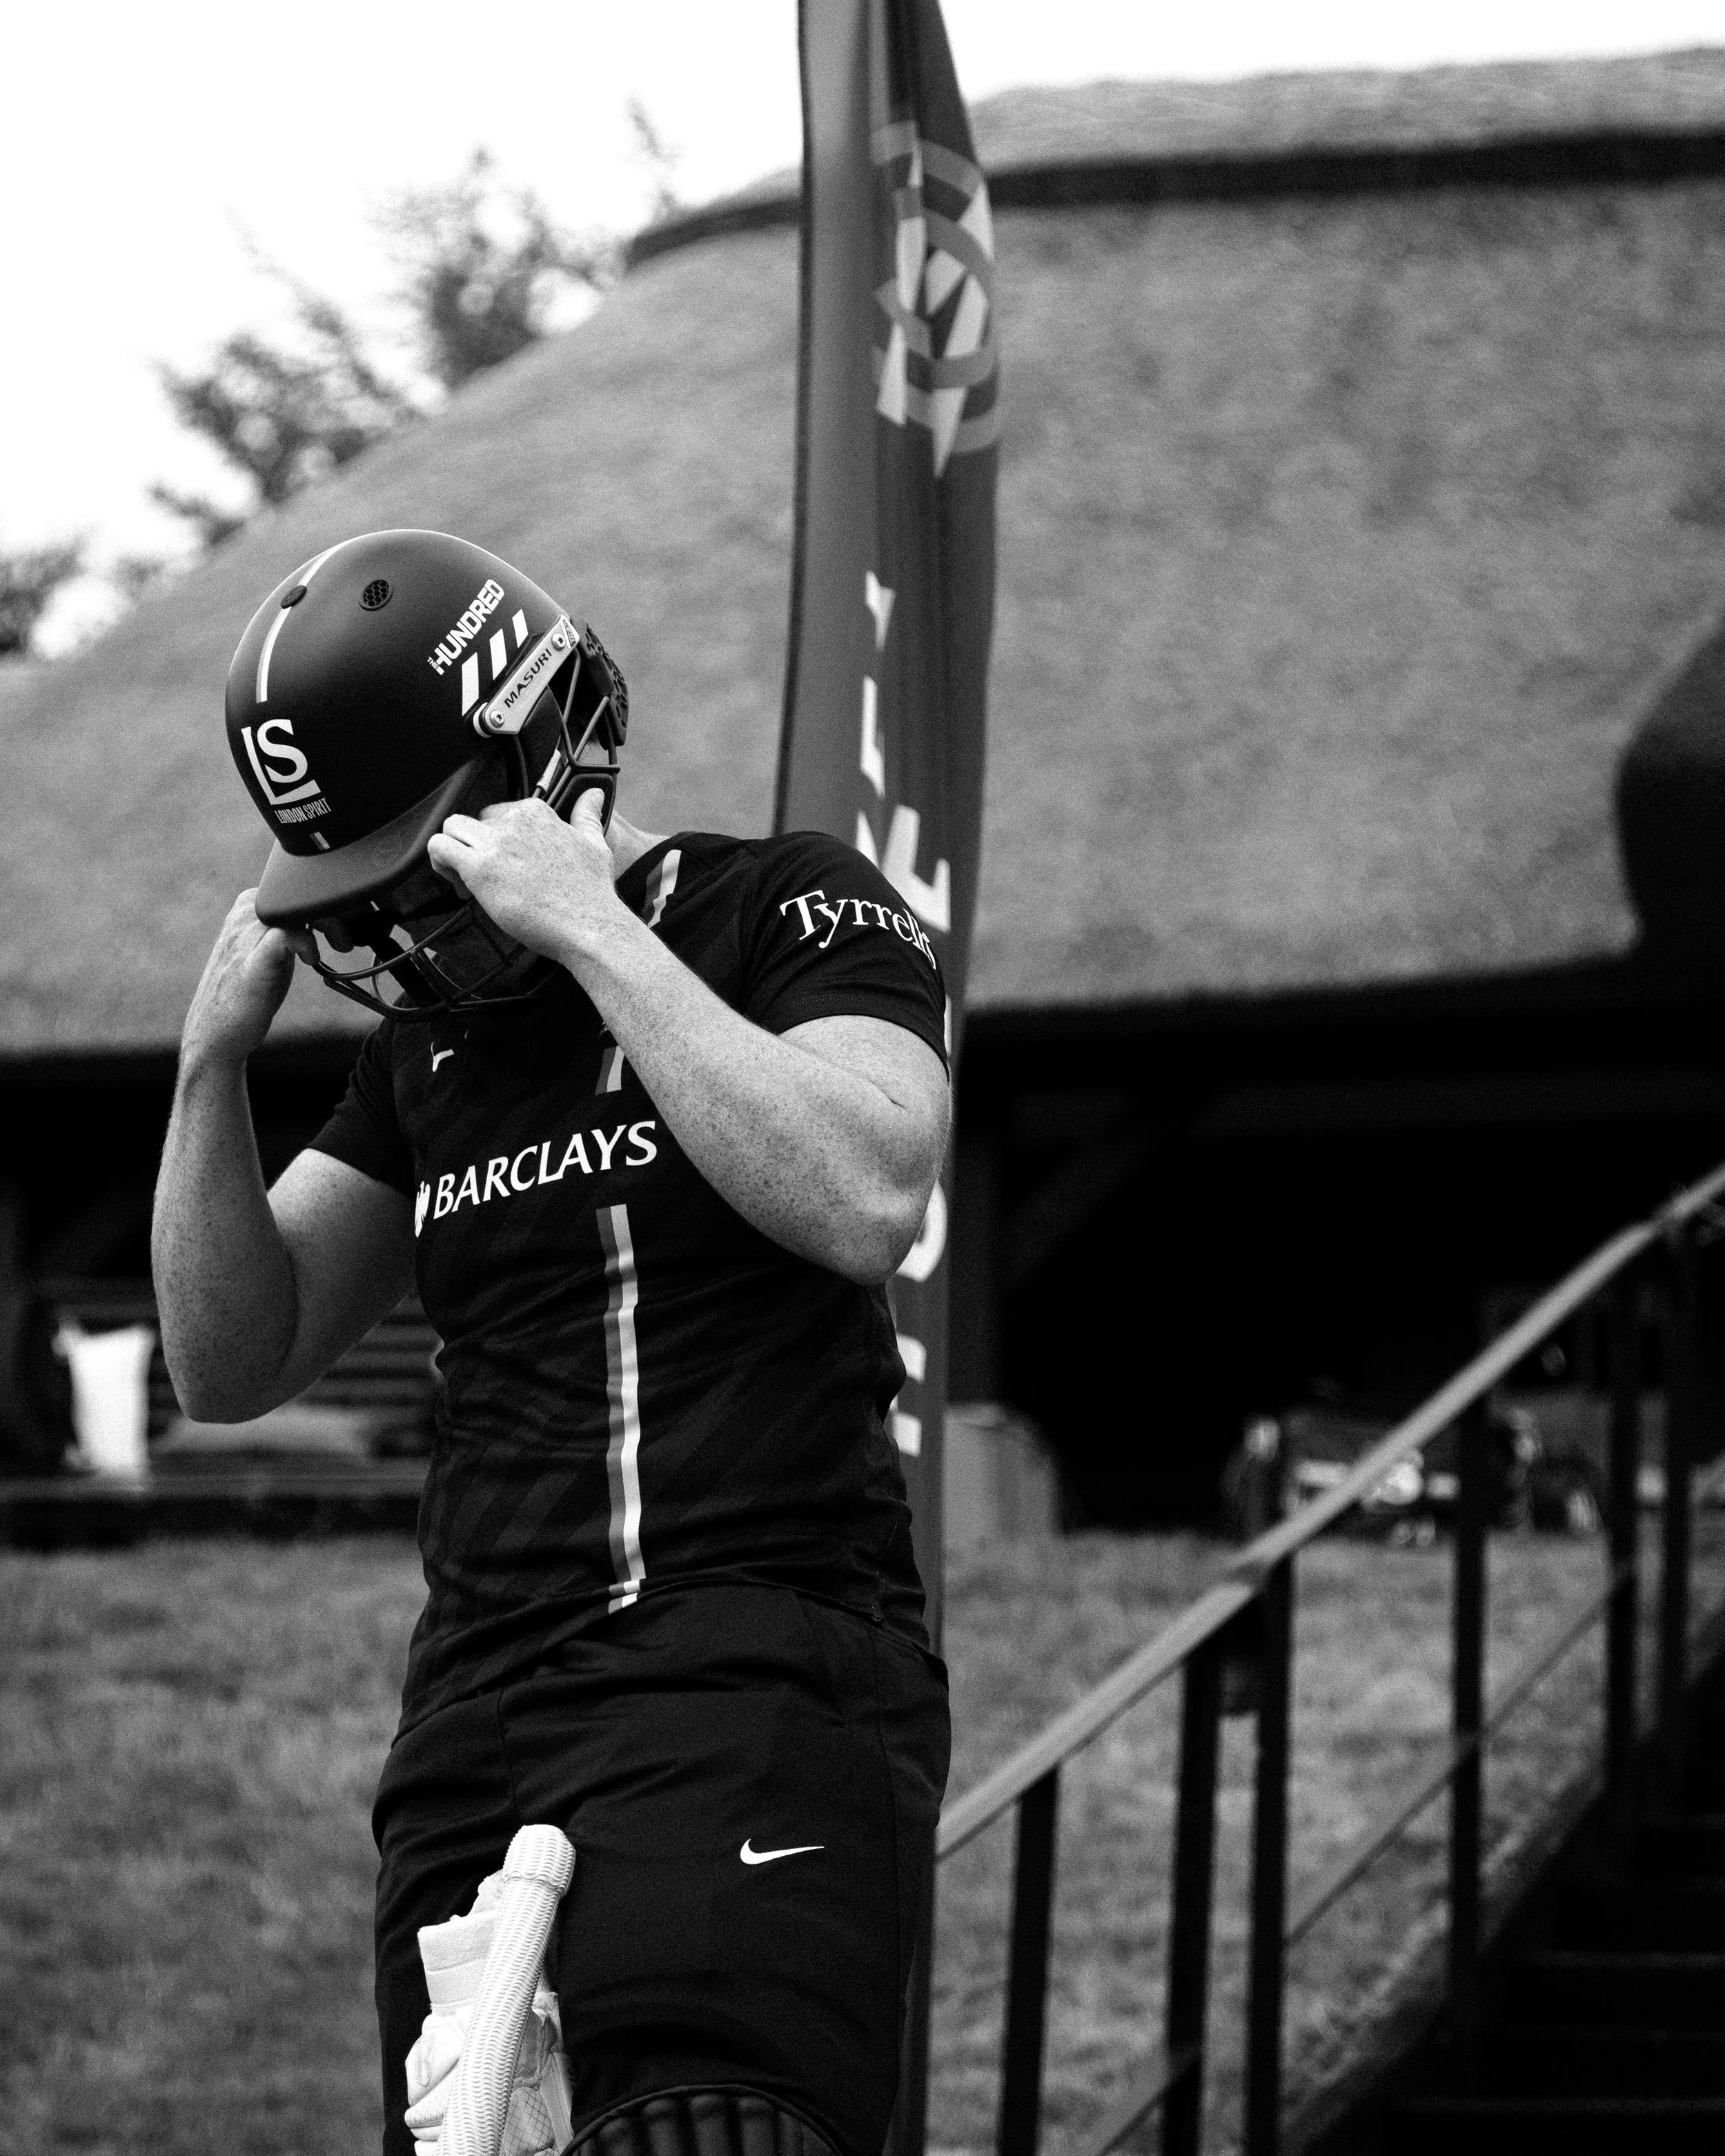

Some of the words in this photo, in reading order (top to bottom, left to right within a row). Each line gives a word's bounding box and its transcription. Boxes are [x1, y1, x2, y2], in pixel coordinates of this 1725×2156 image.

[427, 656, 440, 670] THE
[434, 579, 504, 675] HUNDRED
[504, 648, 551, 708] MASURI
[274, 807, 308, 824] LONDON
[302, 798, 331, 819] SPIRIT
[433, 1120, 658, 1220] BARCLAYS
